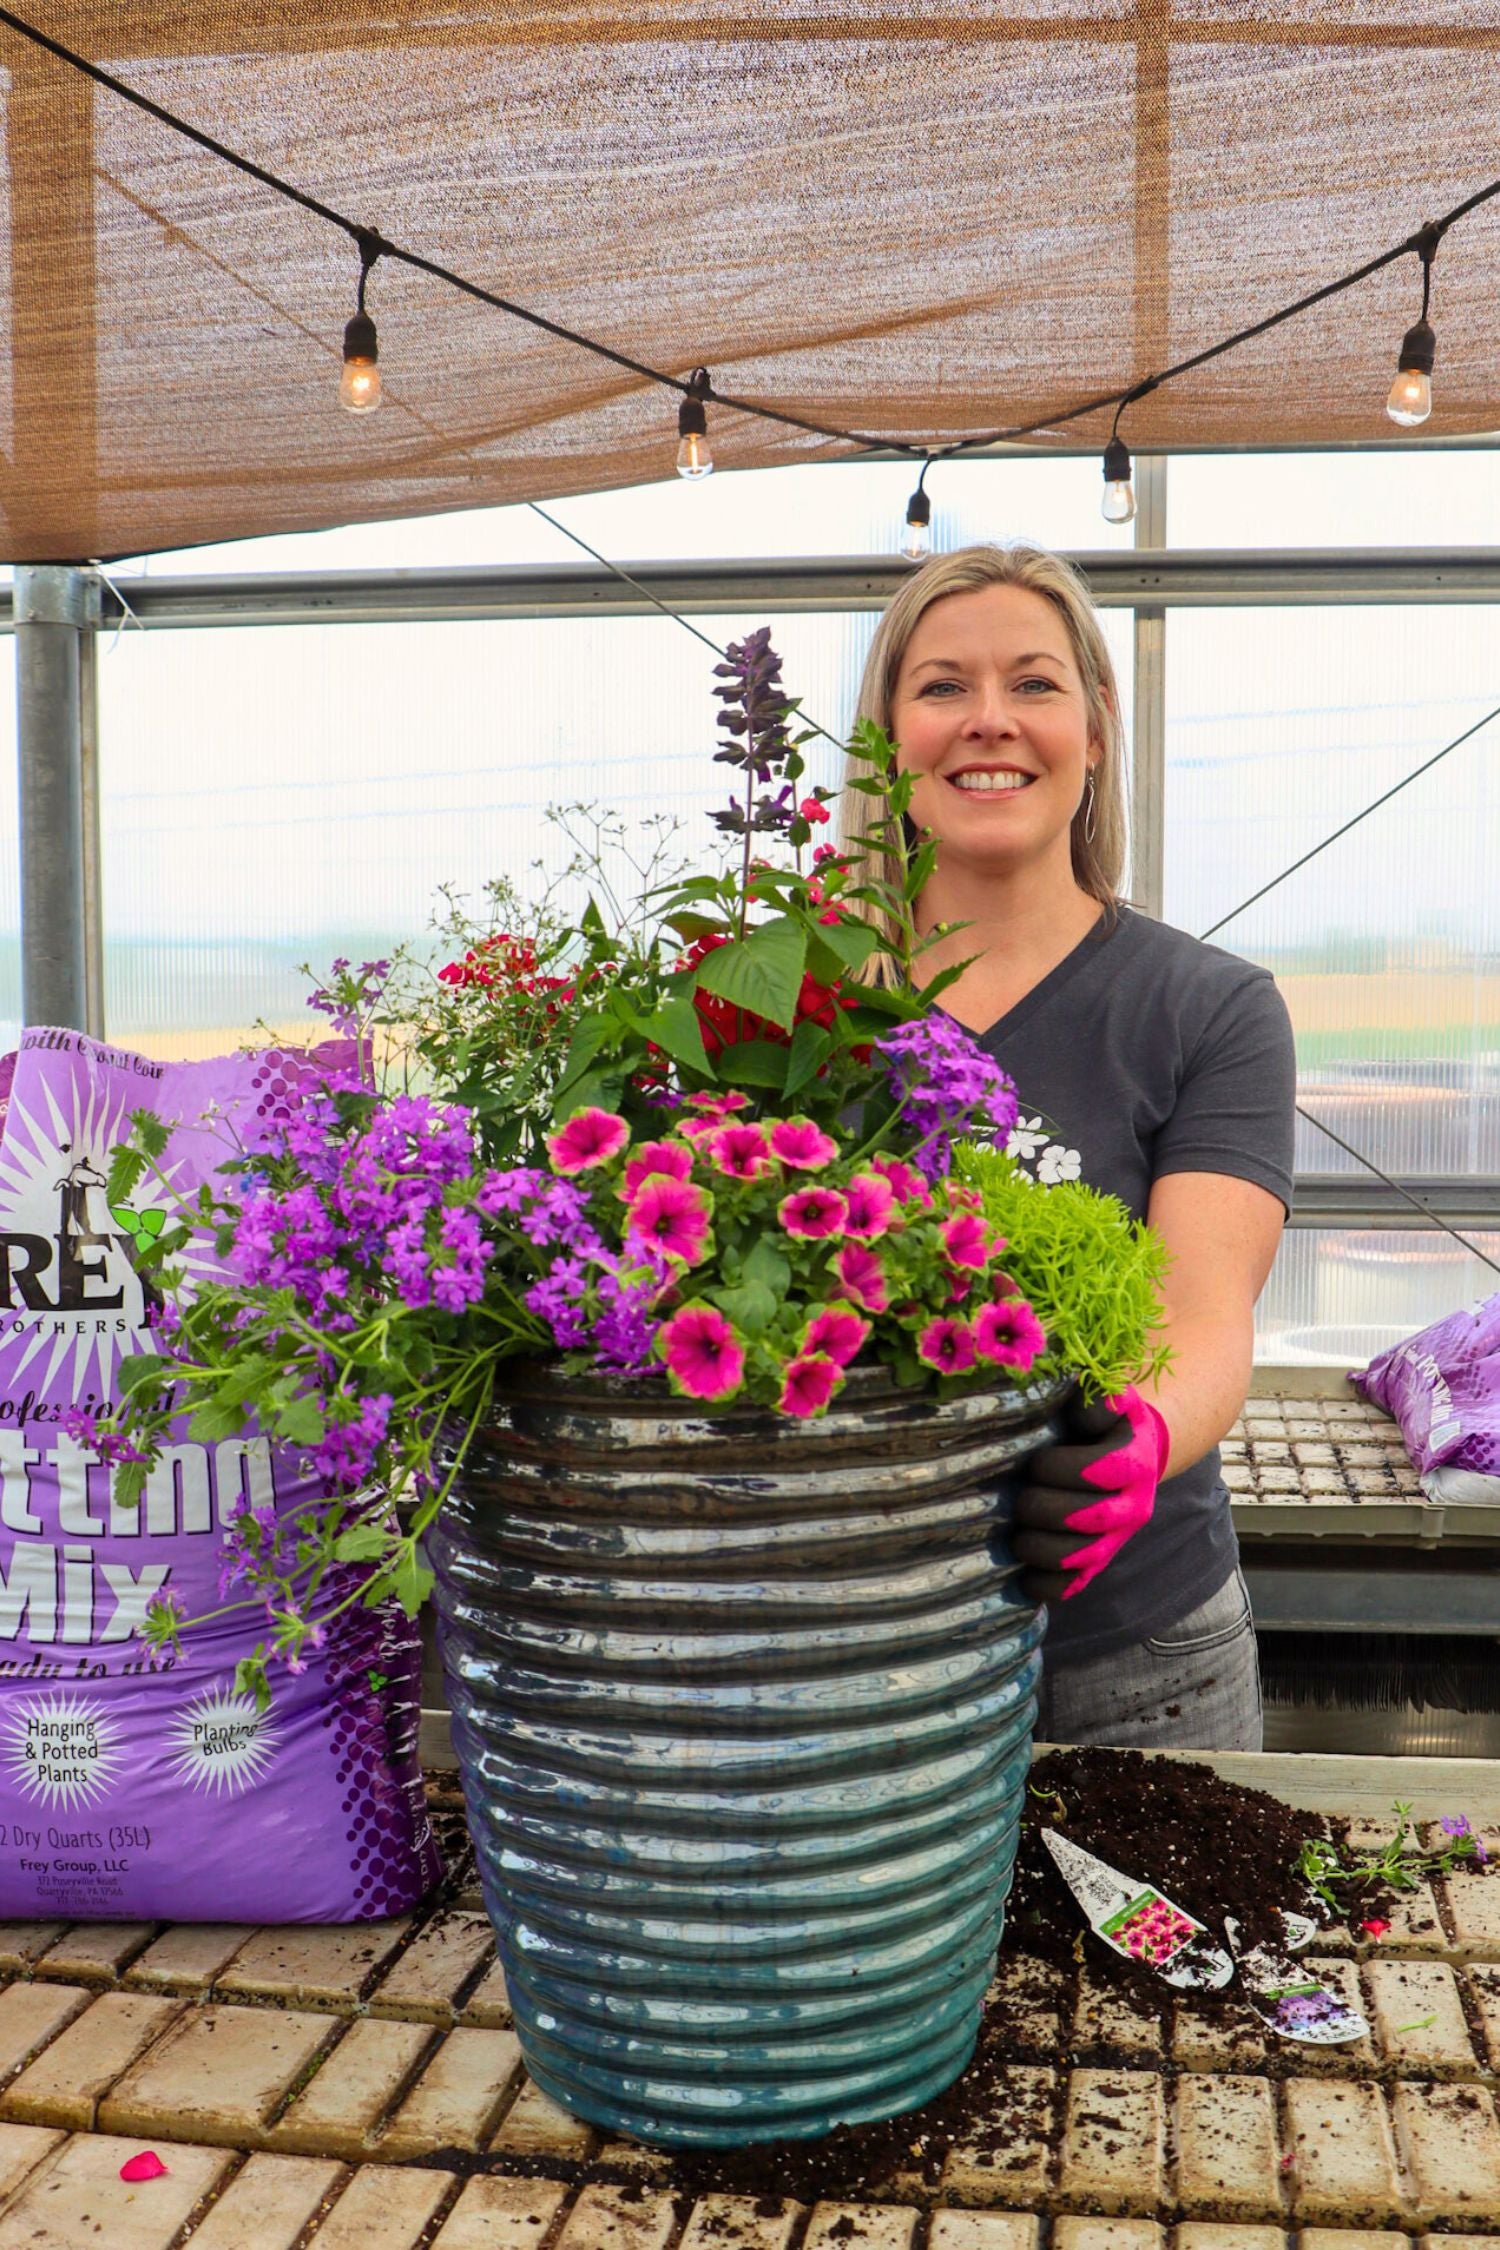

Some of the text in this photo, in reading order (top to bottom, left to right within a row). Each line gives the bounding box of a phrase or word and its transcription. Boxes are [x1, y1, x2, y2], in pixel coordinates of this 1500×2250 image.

[74, 1657, 108, 1678] to
[27, 1718, 96, 1742] Hanging
[194, 1722, 259, 1741] Planting
[25, 1739, 98, 1760] & Potted
[203, 1736, 247, 1756] Bulbs
[38, 1763, 88, 1782] Plants
[13, 1825, 41, 1851] Dry
[47, 1827, 103, 1849] Quarts
[109, 1825, 151, 1851] (35L)
[20, 1858, 49, 1874] Frey
[104, 1859, 130, 1872] LLC
